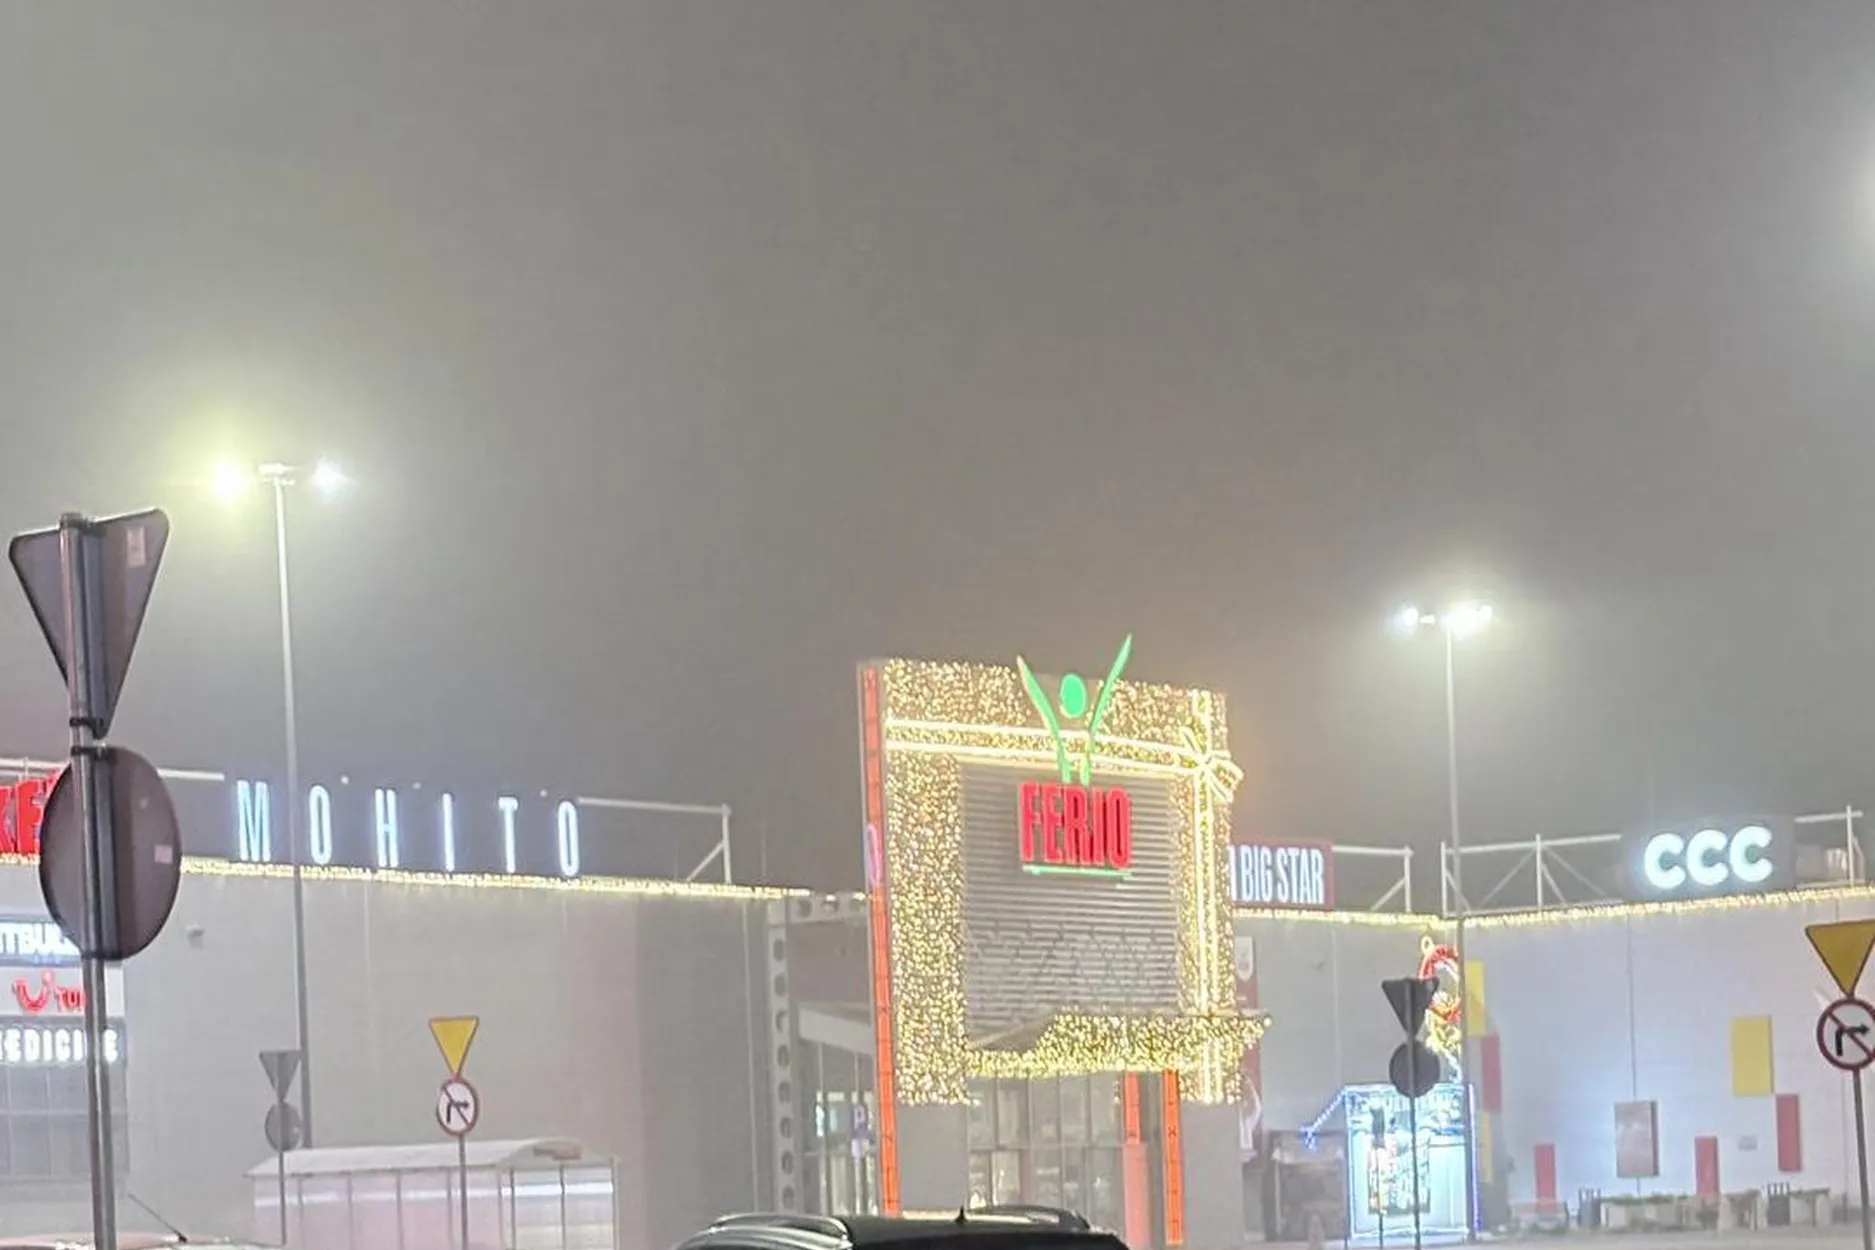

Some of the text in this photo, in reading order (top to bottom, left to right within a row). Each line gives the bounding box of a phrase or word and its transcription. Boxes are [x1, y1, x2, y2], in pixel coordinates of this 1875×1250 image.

[236, 780, 580, 877] MOHITO
[1019, 780, 1133, 868] FERIO
[1644, 825, 1773, 890] CCC
[1240, 844, 1325, 905] BIG STAR
